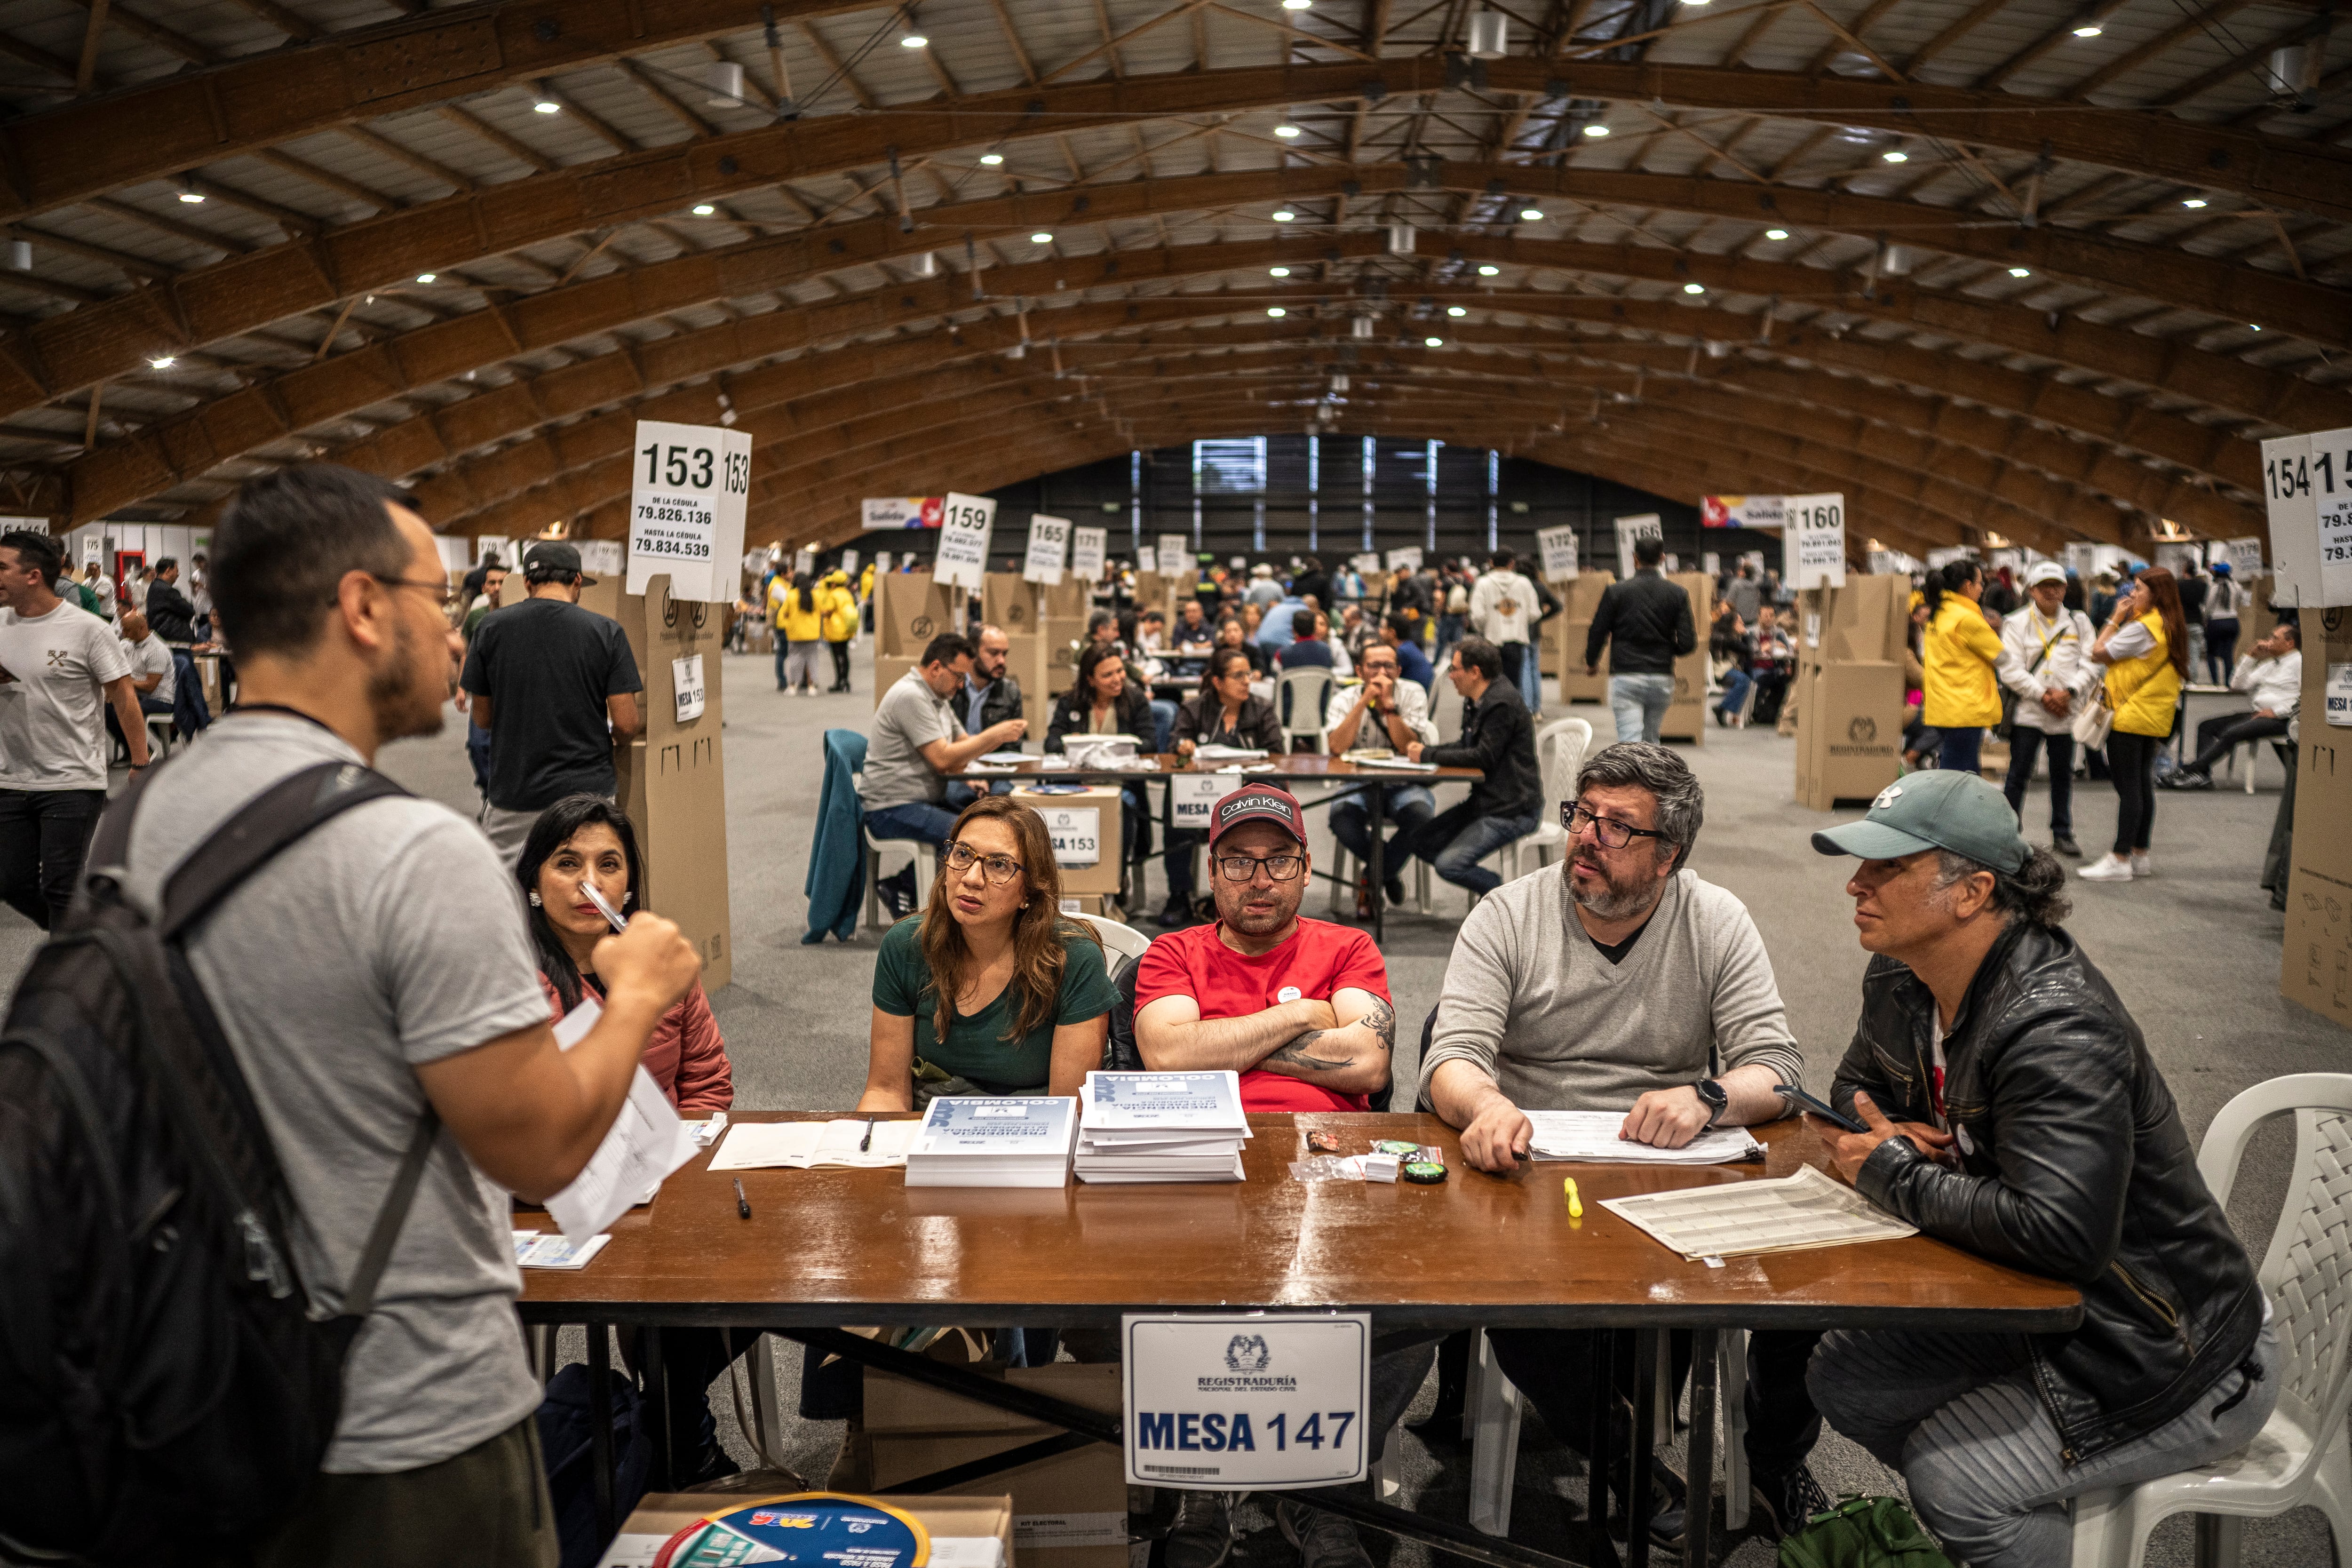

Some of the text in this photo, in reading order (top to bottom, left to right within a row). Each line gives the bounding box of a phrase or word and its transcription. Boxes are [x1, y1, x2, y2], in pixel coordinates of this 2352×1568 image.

[642, 443, 714, 489] 153
[724, 450, 748, 495] 153
[2314, 450, 2352, 493] 1
[2267, 455, 2311, 499] 154
[673, 498, 698, 507] CÉDULA
[637, 505, 711, 525] 79.826.136
[949, 505, 985, 530] 159
[1801, 505, 1840, 529] 160
[644, 528, 664, 536] HASTA
[676, 530, 701, 540] CÉDULA
[1037, 524, 1063, 542] 165
[636, 538, 709, 557] 79.834.539
[678, 688, 703, 708] MESA 153
[2328, 697, 2347, 712] MESA
[1177, 804, 1210, 815] MESA
[1222, 797, 1291, 816] Calvin Klein
[1070, 837, 1095, 850] 153
[1198, 1375, 1297, 1386] REGISTRADURÍA
[1138, 1412, 1355, 1452] MESA 147
[749, 1515, 815, 1528] 2026
